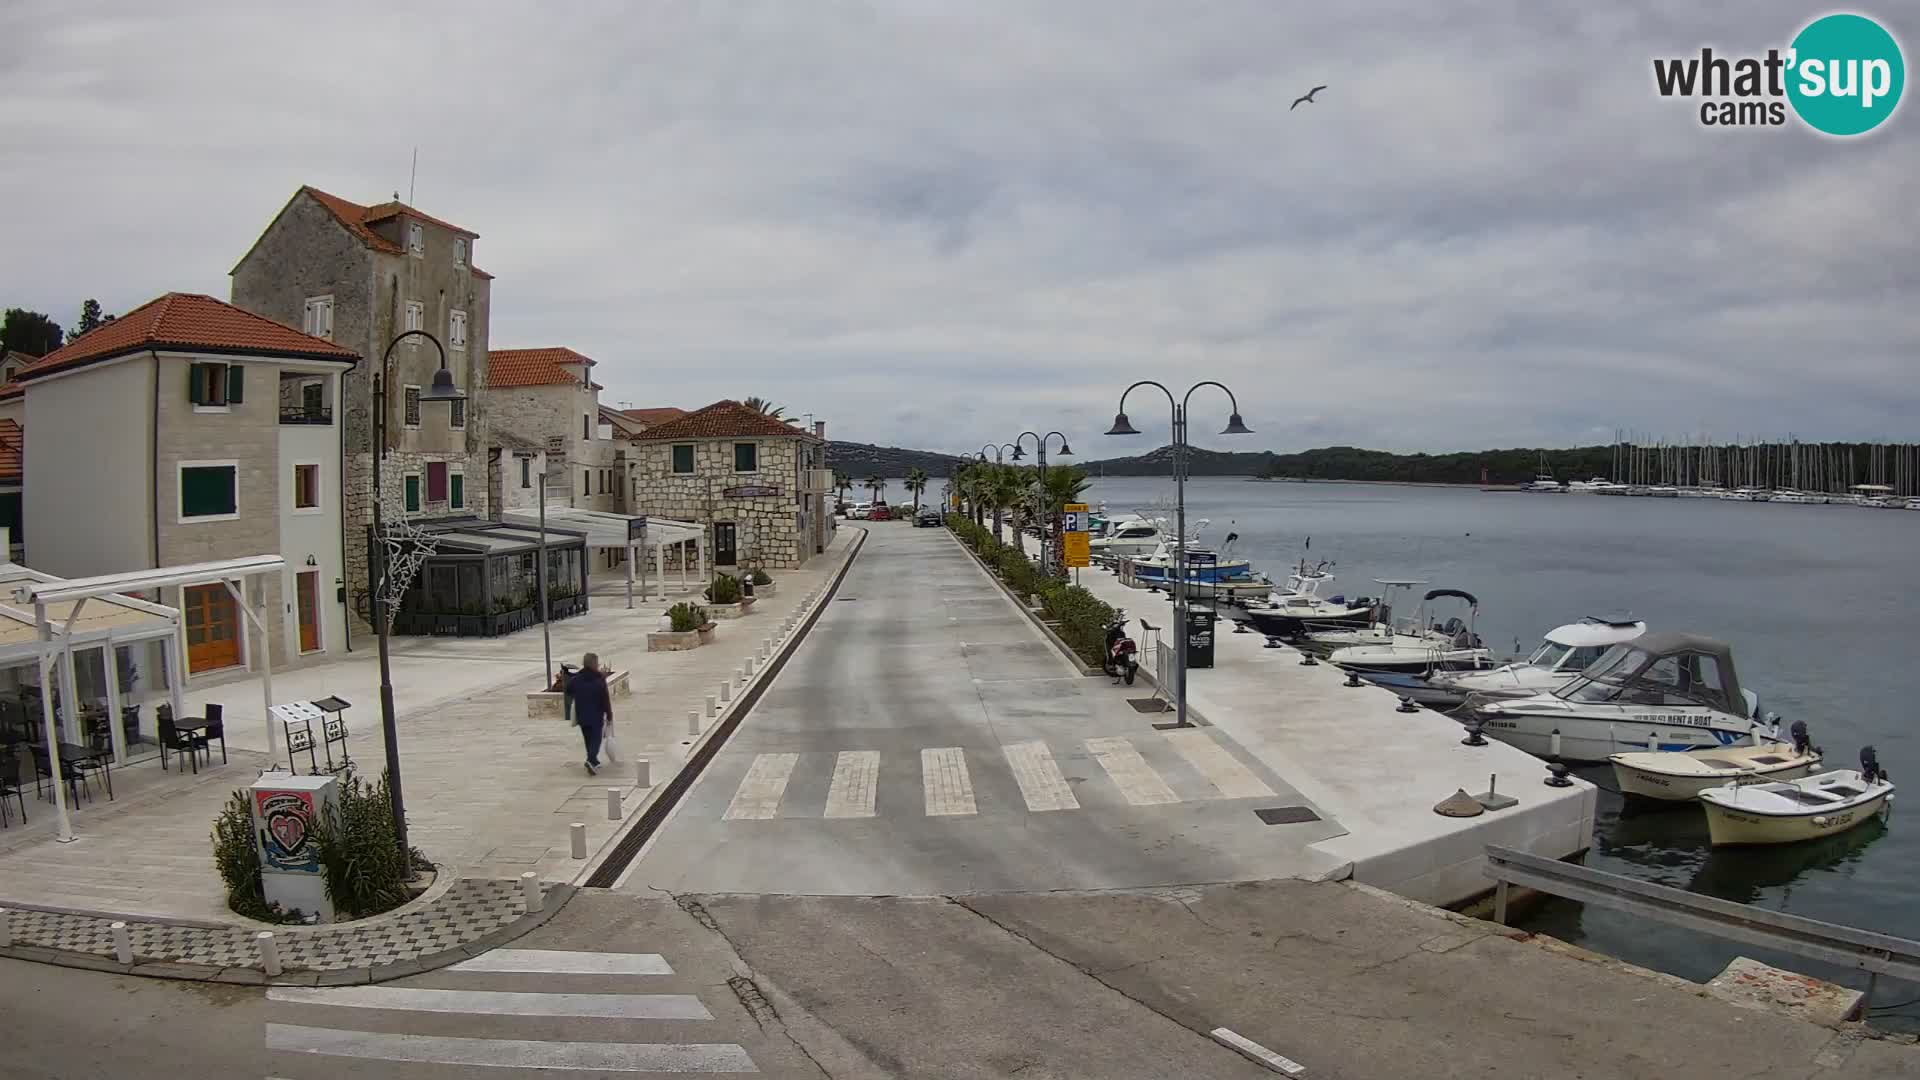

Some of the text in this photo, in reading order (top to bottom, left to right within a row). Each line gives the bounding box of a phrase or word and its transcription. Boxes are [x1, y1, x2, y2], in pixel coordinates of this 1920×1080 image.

[1065, 514, 1076, 530] P
[1667, 714, 1686, 724] RENT
[1693, 715, 1712, 727] BOAT
